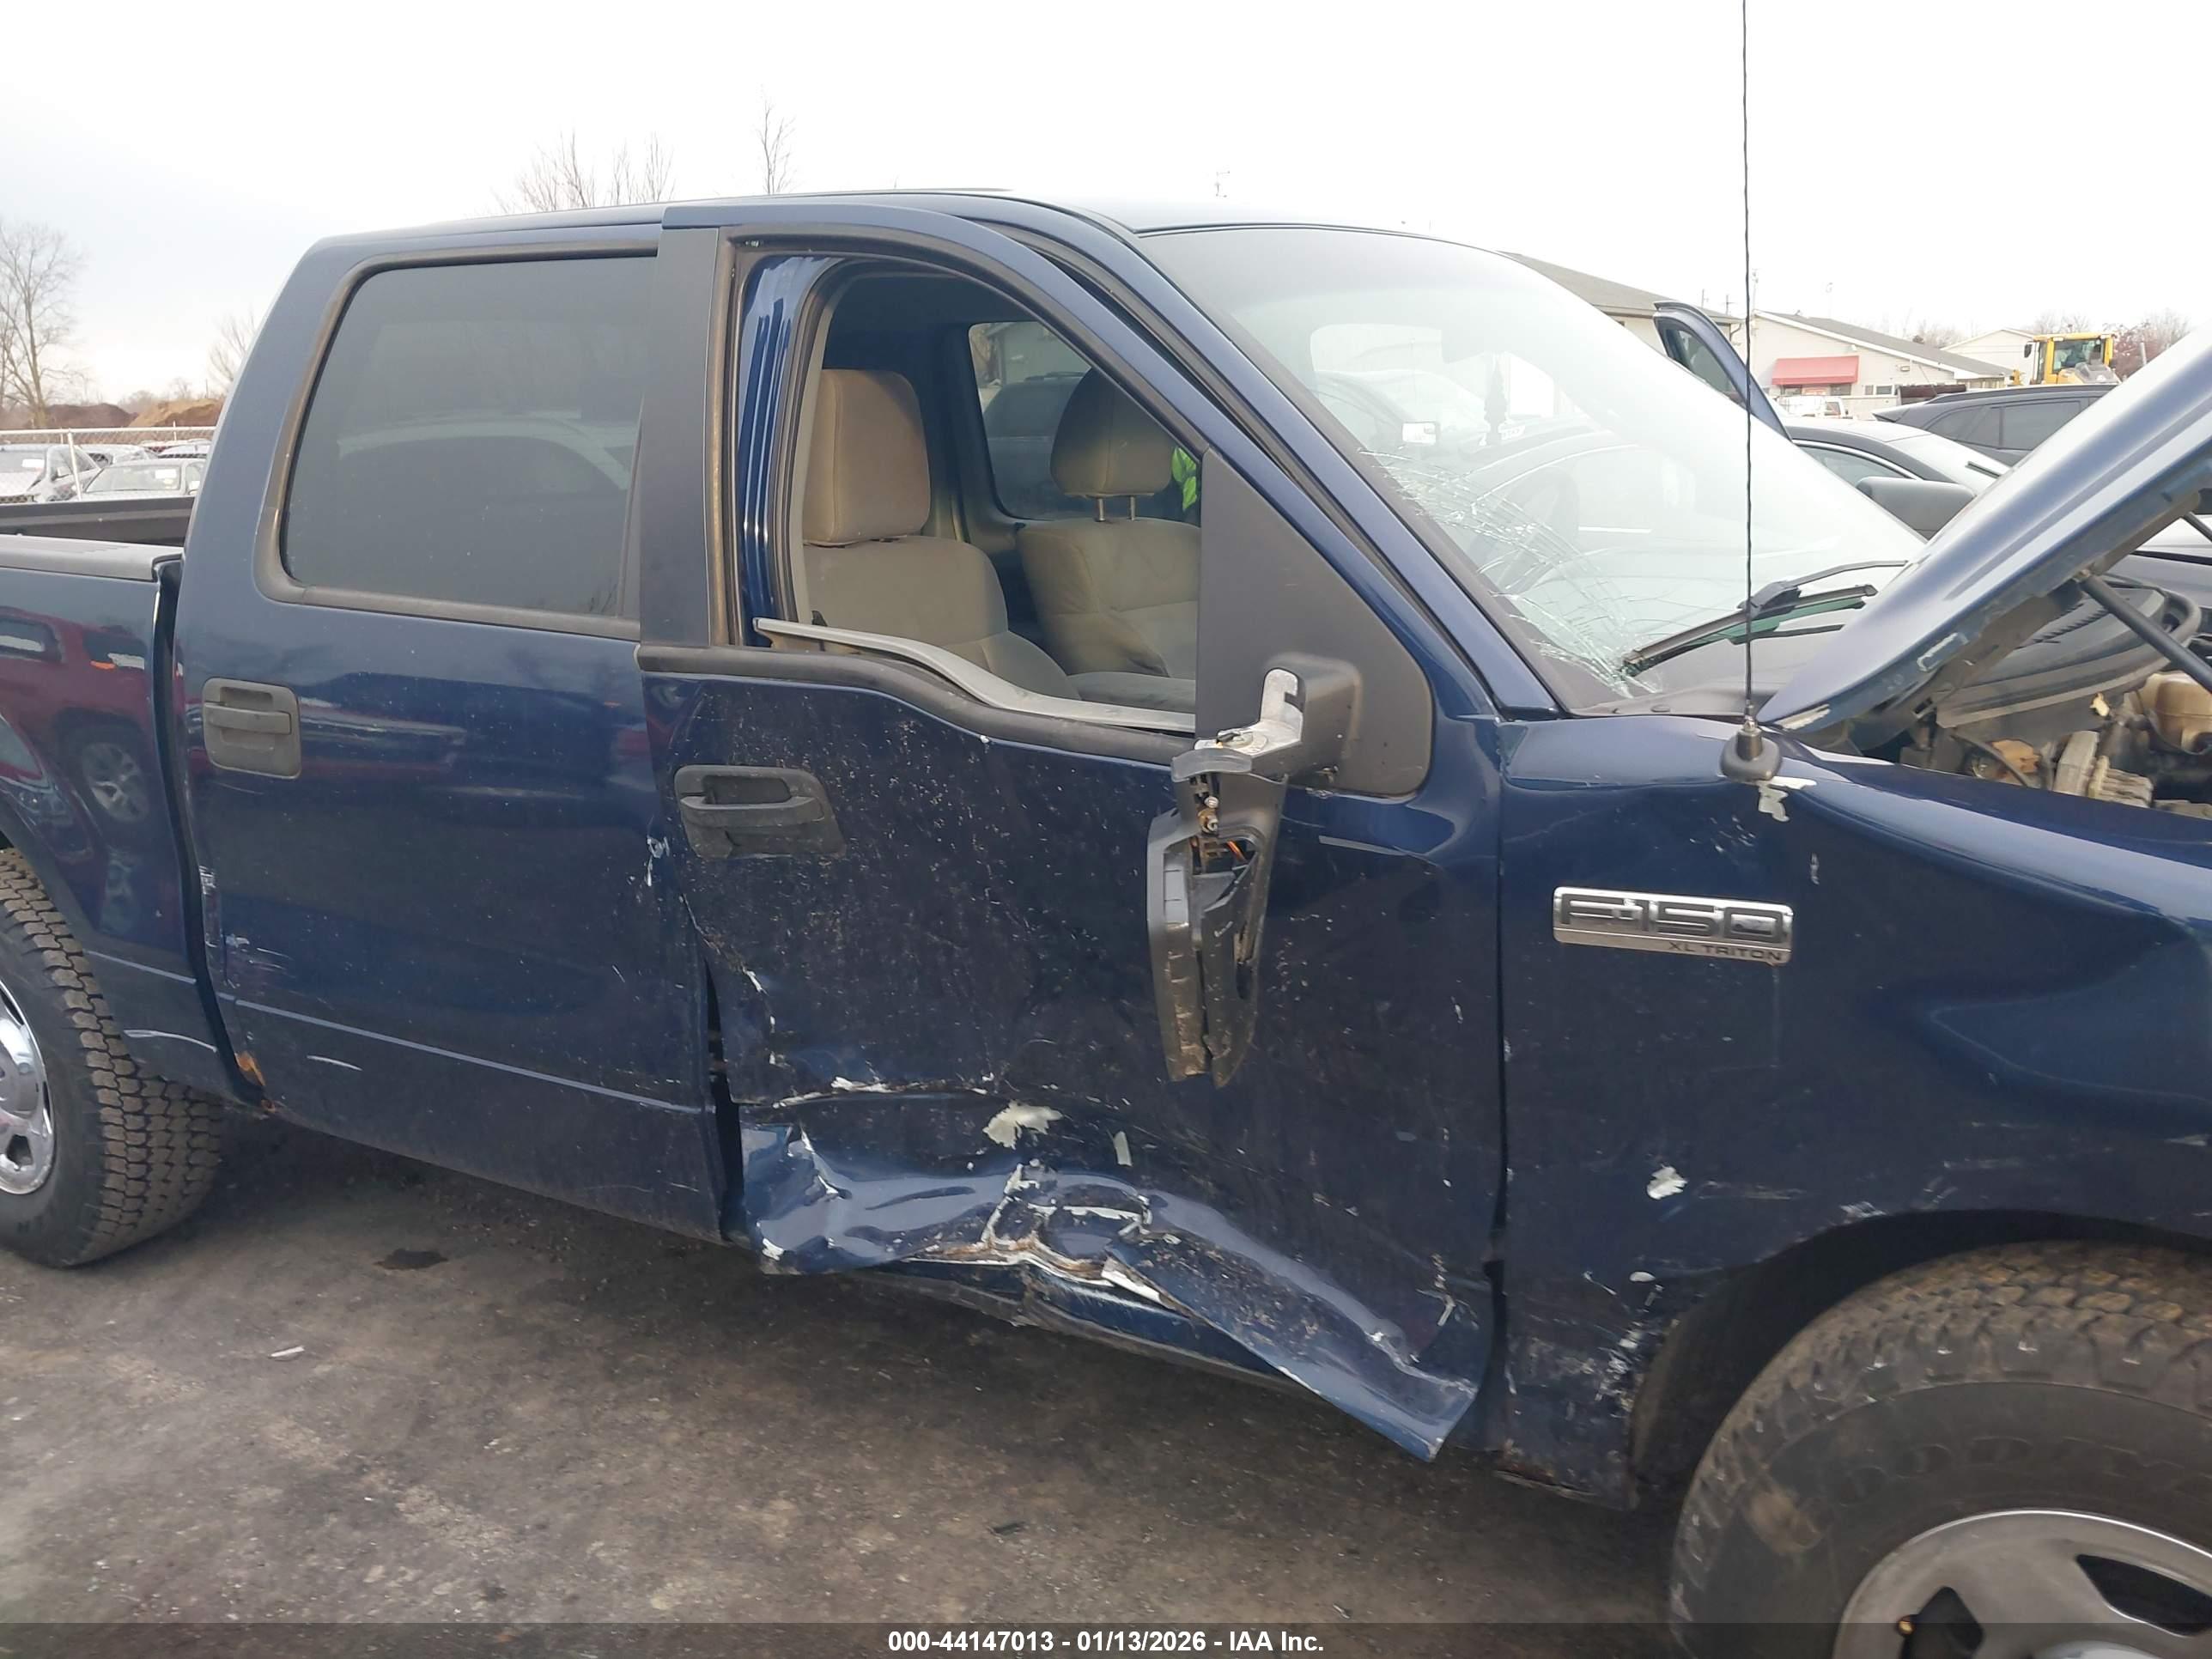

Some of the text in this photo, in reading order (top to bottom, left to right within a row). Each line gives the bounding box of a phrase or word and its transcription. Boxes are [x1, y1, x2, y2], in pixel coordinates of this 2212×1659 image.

[1559, 892, 1789, 944] F-150
[1668, 941, 1782, 961] XL TRITON
